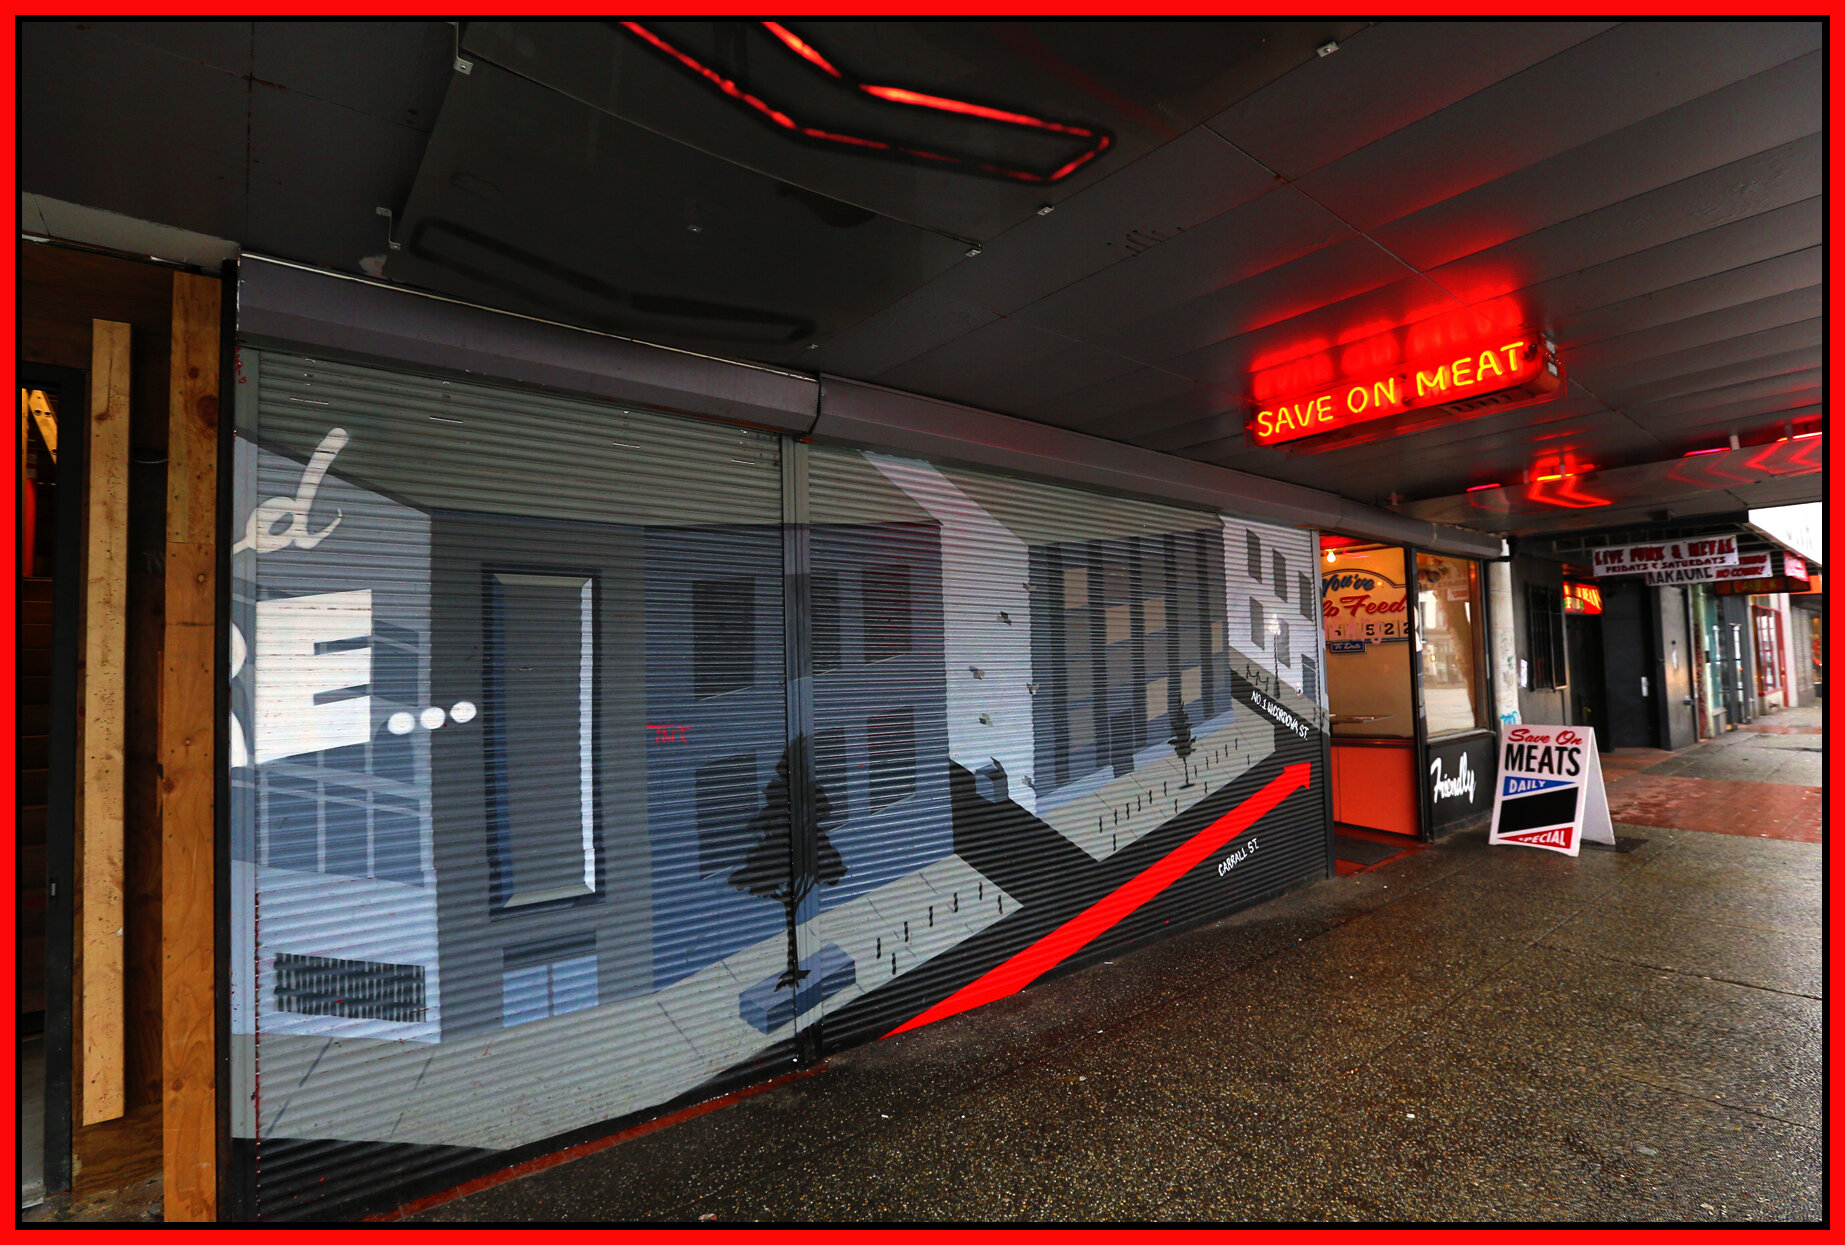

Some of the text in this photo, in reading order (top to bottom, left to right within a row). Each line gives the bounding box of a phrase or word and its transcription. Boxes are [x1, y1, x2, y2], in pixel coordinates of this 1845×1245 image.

[1256, 340, 1525, 438] SAVE ON MEAT
[1594, 548, 1625, 566] LIVE
[1671, 544, 1683, 560] &
[1688, 538, 1736, 558] METAL
[1605, 562, 1649, 574] FRIDAYS
[1660, 556, 1727, 570] SATURDAYS
[1323, 594, 1407, 617] lp Feed
[232, 588, 477, 768] E...
[1508, 728, 1583, 746] Save On
[1504, 743, 1582, 777] MEATS
[1430, 751, 1477, 804] Friendly
[1508, 779, 1547, 794] DAILY
[1218, 847, 1248, 877] CARRALL
